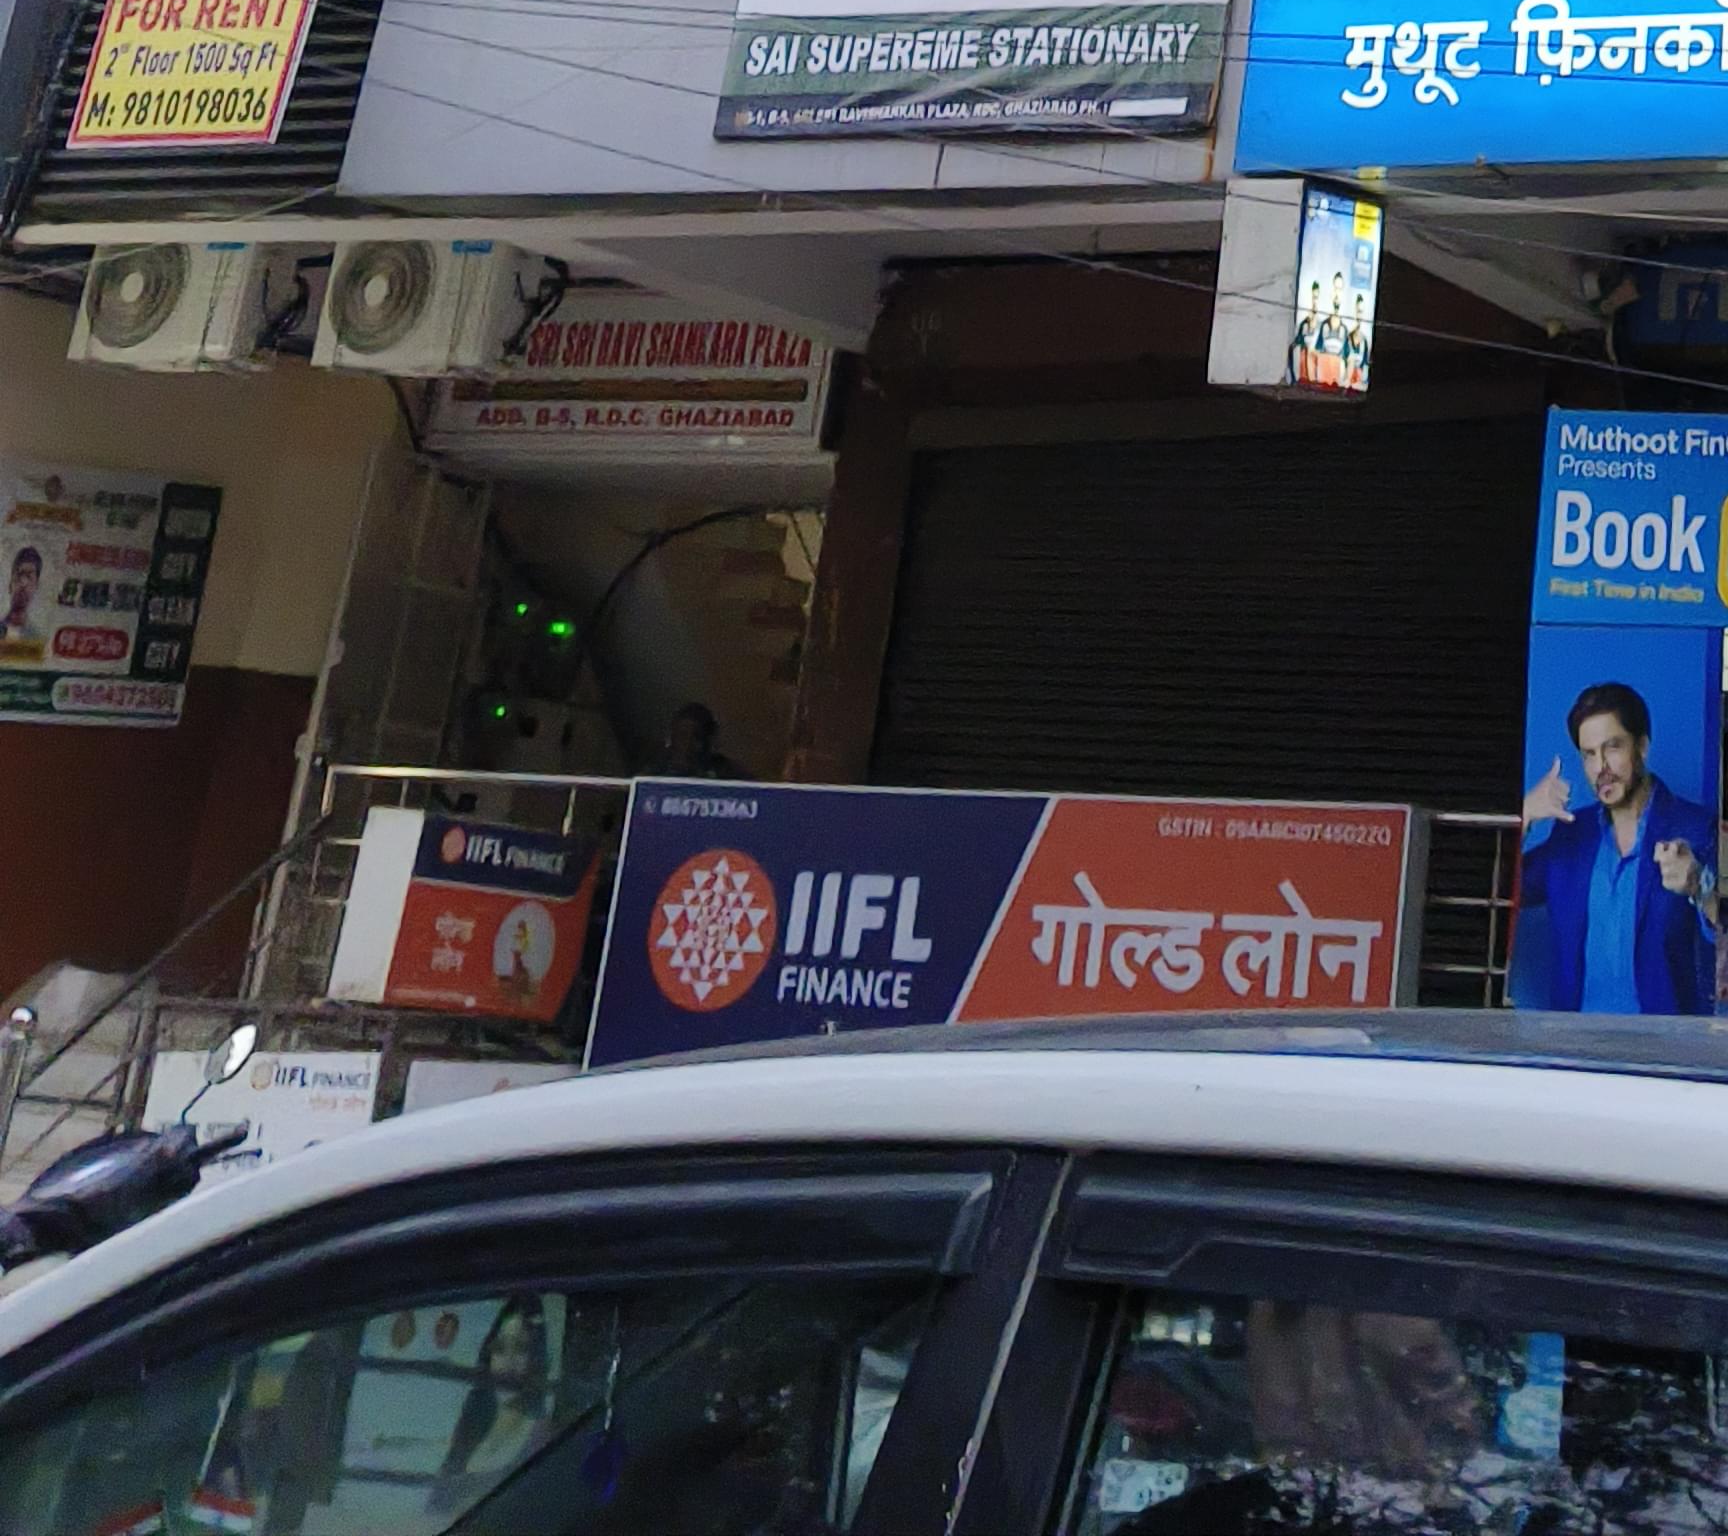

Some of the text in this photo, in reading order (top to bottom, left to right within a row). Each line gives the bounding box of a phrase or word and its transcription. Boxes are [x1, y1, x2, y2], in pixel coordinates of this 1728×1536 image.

[130, 44, 181, 77] Floor
[184, 41, 228, 75] 1500
[228, 42, 253, 80] Sq
[744, 21, 1200, 77] SAI SUPEREME STATIONARY
[1341, 18, 1486, 109] मुथूट
[85, 86, 269, 127] M: 9810198036
[750, 321, 813, 369] PLAZA
[656, 407, 795, 428] GHAZIABAD
[1559, 423, 1679, 455] Muthoot
[1557, 454, 1656, 480] Presents
[1551, 489, 1707, 573] Book
[465, 834, 504, 866] IIFL
[783, 869, 933, 964] IIFL
[1030, 870, 1384, 1004] गोल्ड लोन
[776, 963, 912, 1009] FINANCE
